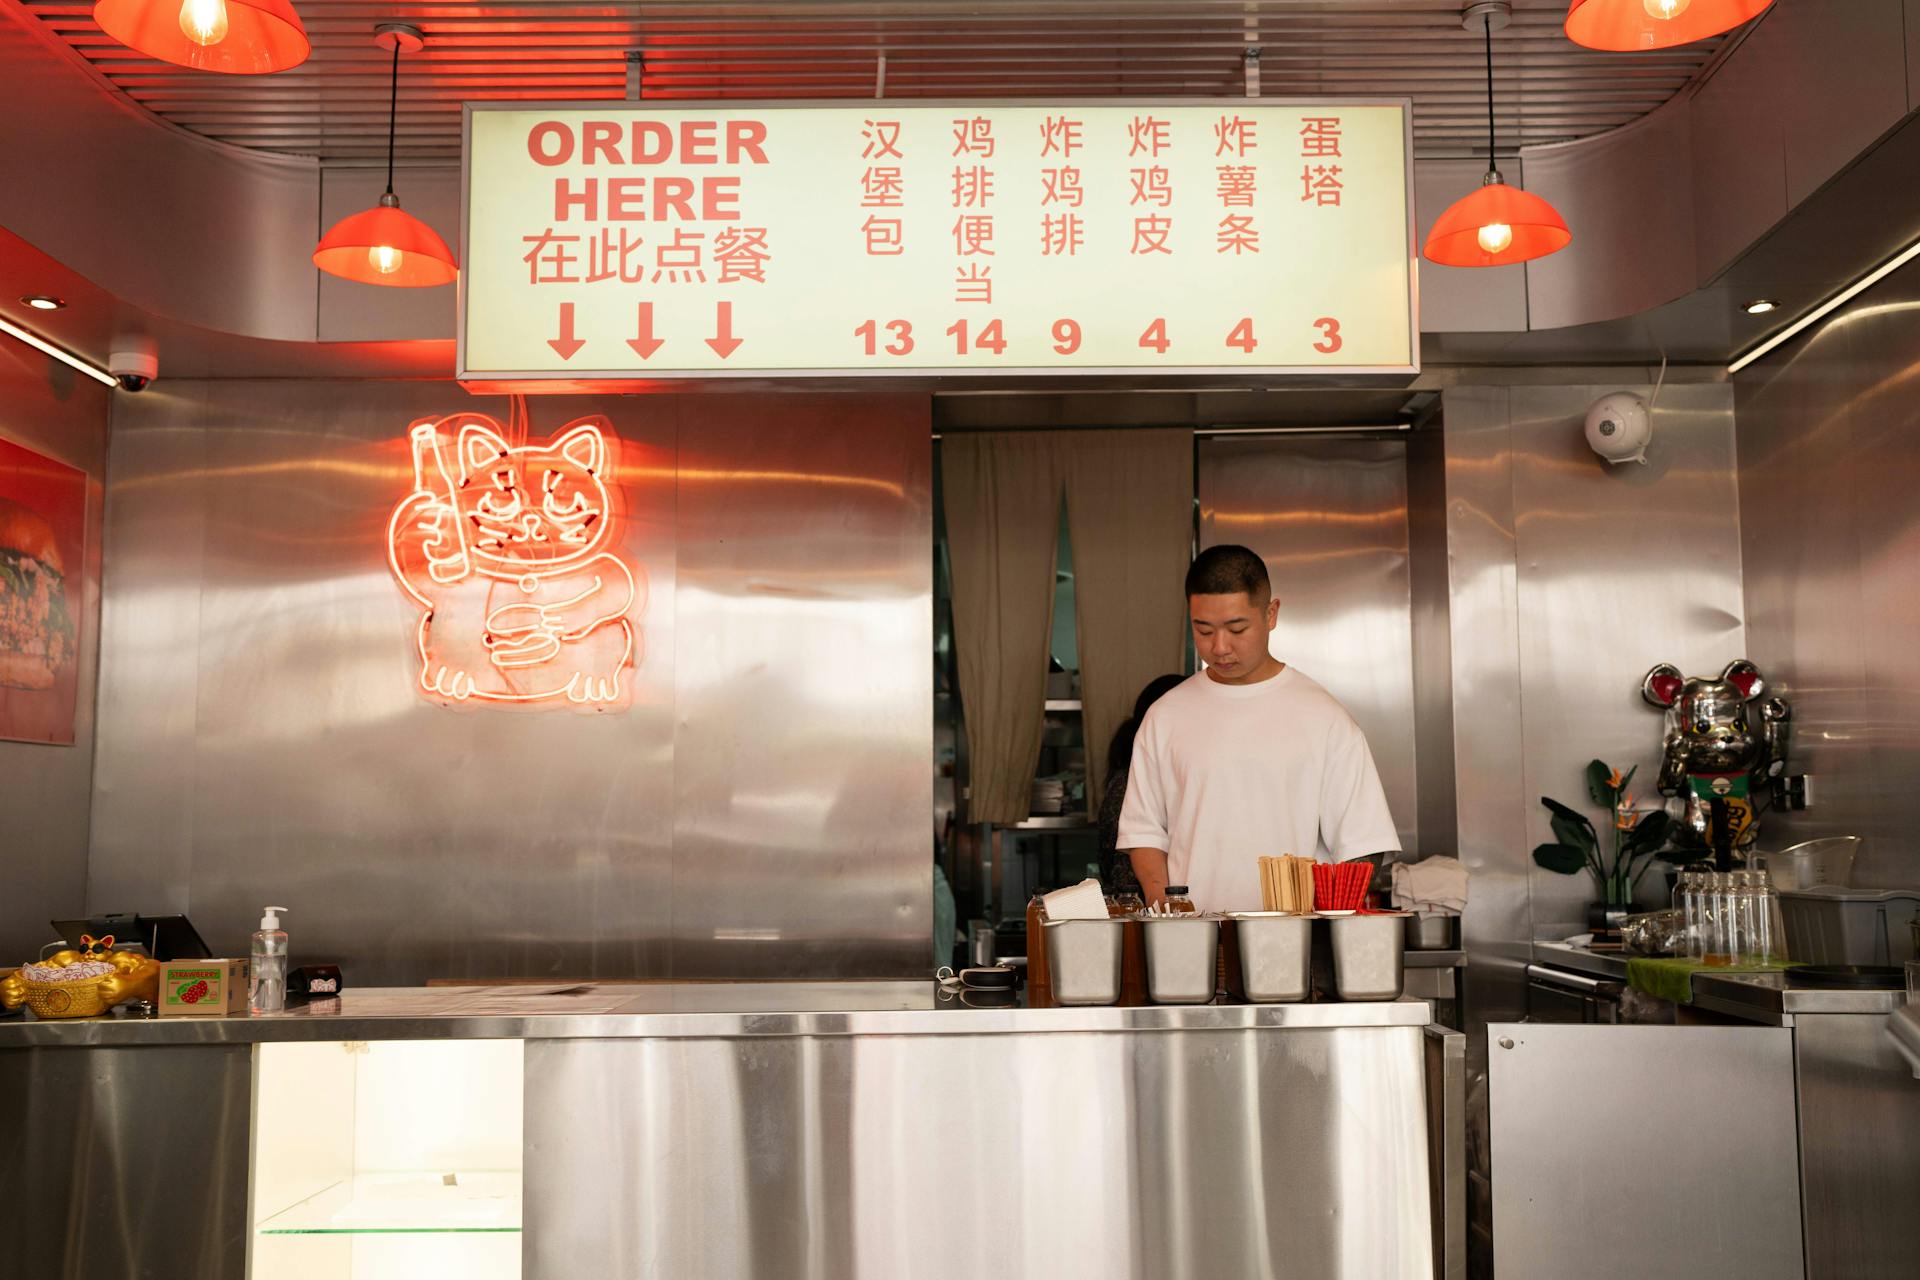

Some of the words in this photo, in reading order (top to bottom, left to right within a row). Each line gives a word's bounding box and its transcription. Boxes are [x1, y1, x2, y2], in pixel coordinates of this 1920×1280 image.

[528, 121, 768, 166] ORDER
[1300, 117, 1344, 207] 蛋塔
[555, 177, 741, 221] HERE
[861, 119, 904, 256] 汉堡包
[1040, 116, 1083, 255] 炸鸡排
[1129, 116, 1172, 255] 炸鸡皮
[1215, 115, 1259, 255] 炸薯条
[952, 117, 995, 303] 鸡排便当
[523, 227, 770, 285] 在此点餐
[855, 320, 914, 355] 13
[947, 319, 1006, 354] 14
[1052, 319, 1082, 355] 9
[1139, 318, 1171, 353] 4
[1226, 318, 1257, 352] 4
[1314, 317, 1343, 354] 3
